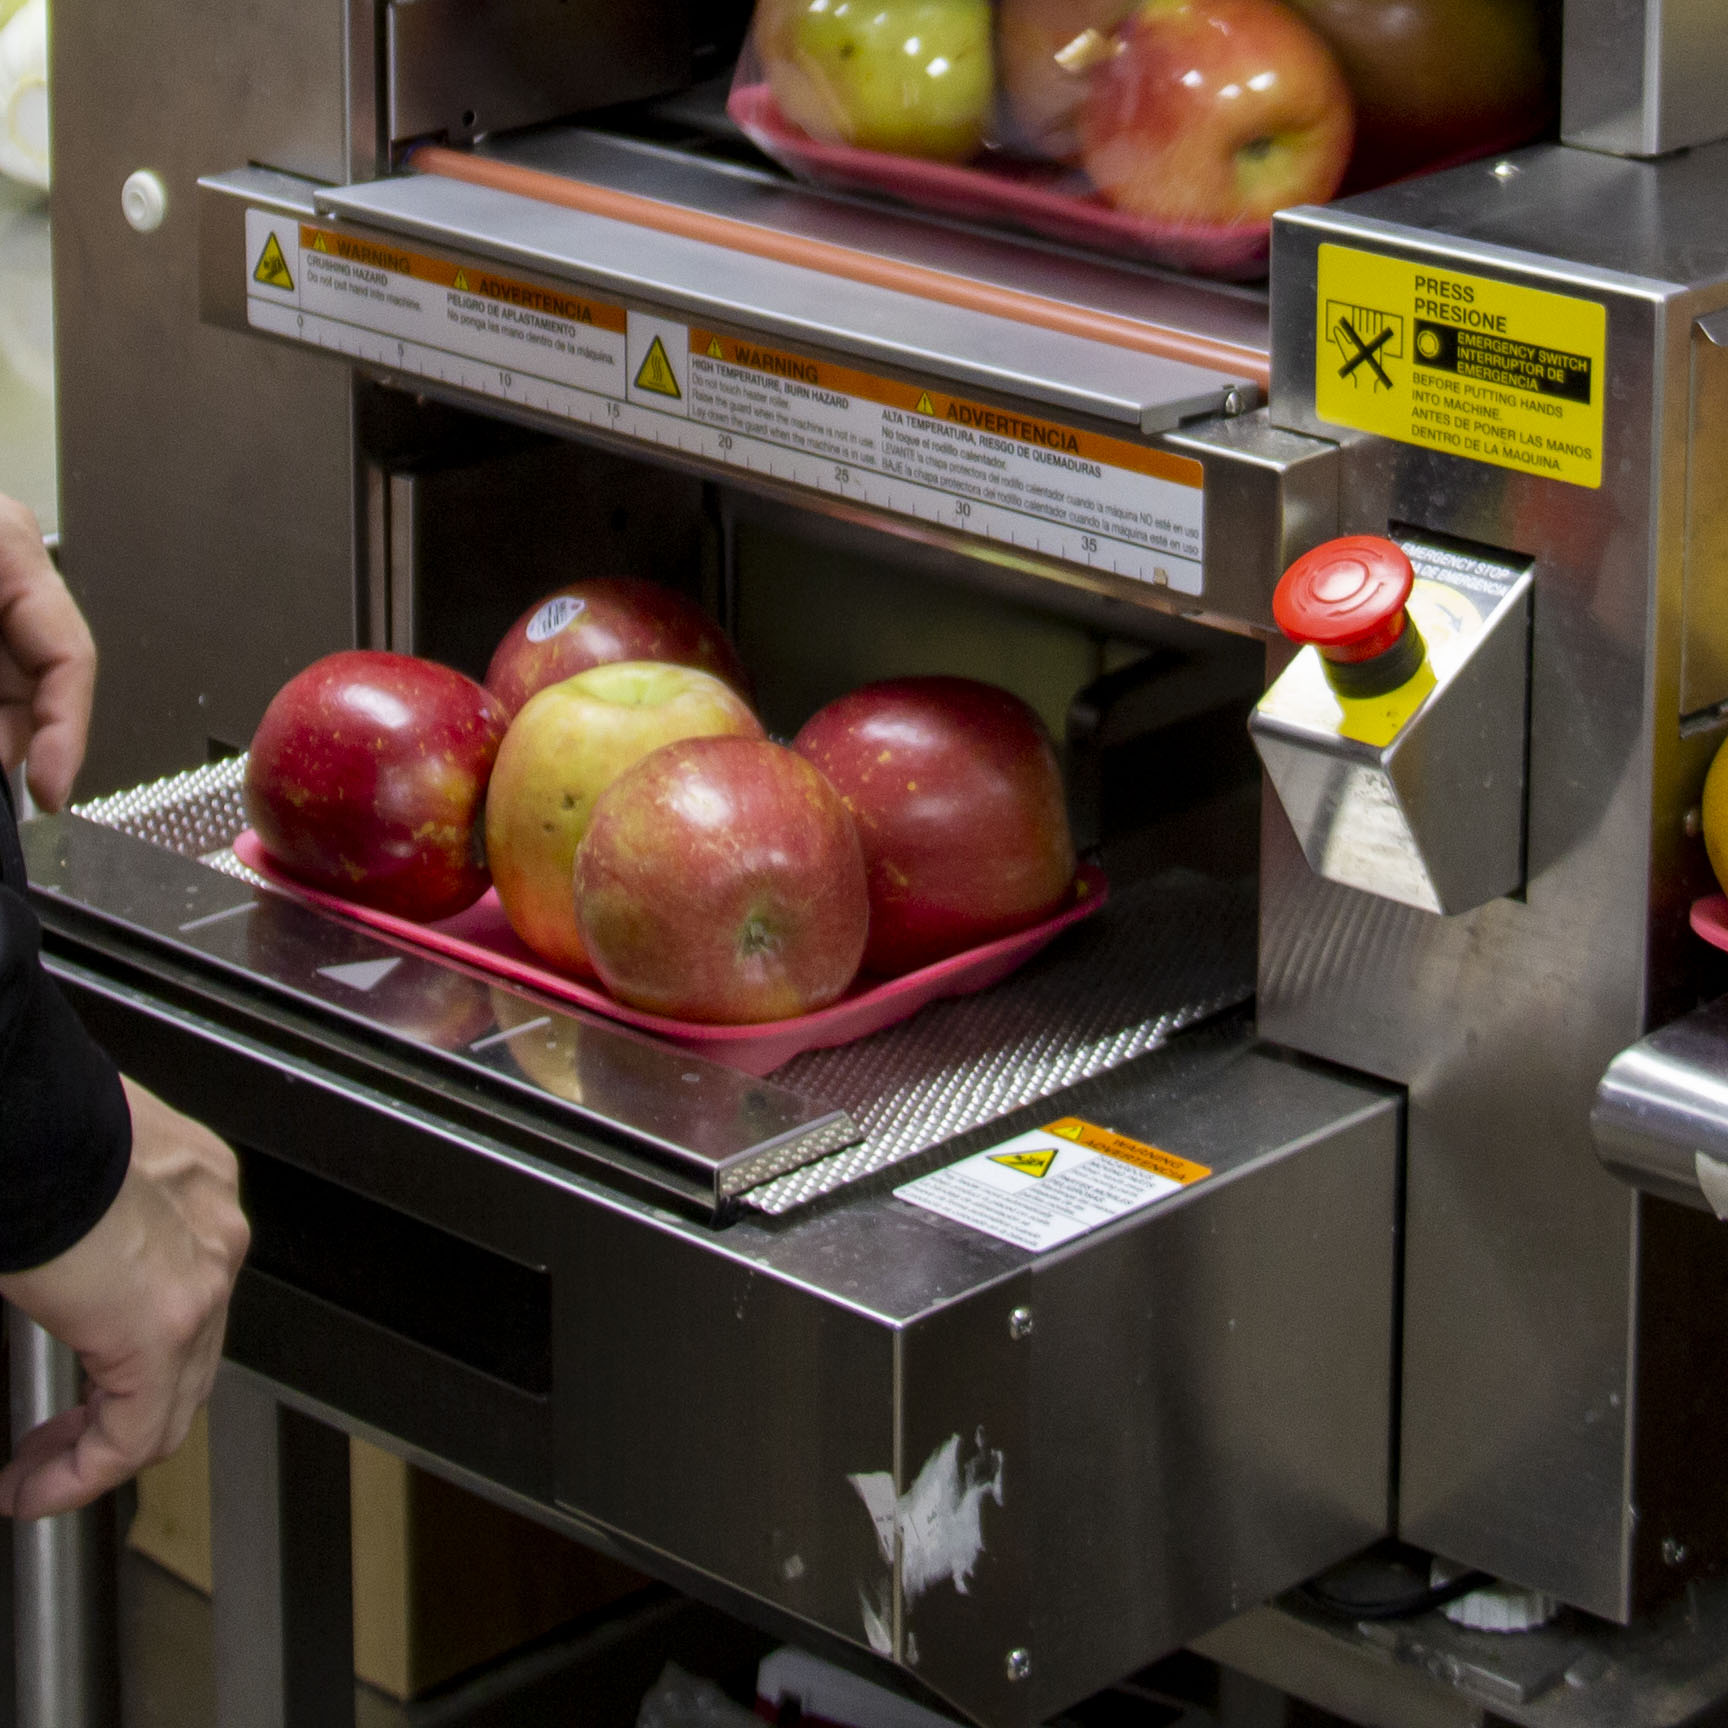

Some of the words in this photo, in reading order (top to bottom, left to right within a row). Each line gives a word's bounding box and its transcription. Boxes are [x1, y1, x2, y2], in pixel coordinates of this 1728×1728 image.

[337, 239, 411, 274] WARNING
[352, 266, 389, 287] HAZARD
[1414, 275, 1475, 303] PRESS
[446, 291, 485, 314] PELIGRO
[479, 278, 593, 323] ADVERTENCIA
[1413, 297, 1508, 334] PRESIONE
[735, 344, 819, 385] WARNING
[1456, 330, 1536, 362] EMERGENCY
[1538, 349, 1588, 373] SWITCH
[1456, 345, 1544, 379] INTERRUPTOR
[1547, 368, 1565, 384] DE
[499, 372, 512, 388] 10
[691, 358, 714, 374] HIGH
[783, 381, 811, 400] BURN
[811, 388, 849, 410] HAZARD
[1456, 361, 1540, 392] EMERGENCIA
[606, 402, 621, 420] 15
[1412, 373, 1462, 394] BEFORE
[1463, 384, 1518, 408] PUTTING
[1519, 399, 1564, 419] HANDS
[1412, 390, 1441, 408] INTO
[718, 433, 733, 450] 20
[881, 408, 903, 424] ALTA
[978, 434, 1015, 455] RIESGO
[1017, 445, 1030, 458] DE
[1032, 448, 1102, 479] QUEMADURAS
[946, 402, 1080, 454] ADVERTENCIA
[1411, 406, 1451, 426] ANTES
[1453, 416, 1471, 431] DE
[1473, 421, 1517, 442] PONER
[1519, 431, 1544, 449] LAS
[1545, 438, 1593, 461] MANOS
[1411, 424, 1461, 447] DENTRO
[1463, 437, 1481, 452] DE
[1483, 442, 1500, 456] LA
[834, 465, 850, 484] 25
[955, 500, 971, 517] 30
[1081, 535, 1098, 553] 35
[1400, 541, 1477, 572] EMERGENCY
[1473, 562, 1511, 580] STOP
